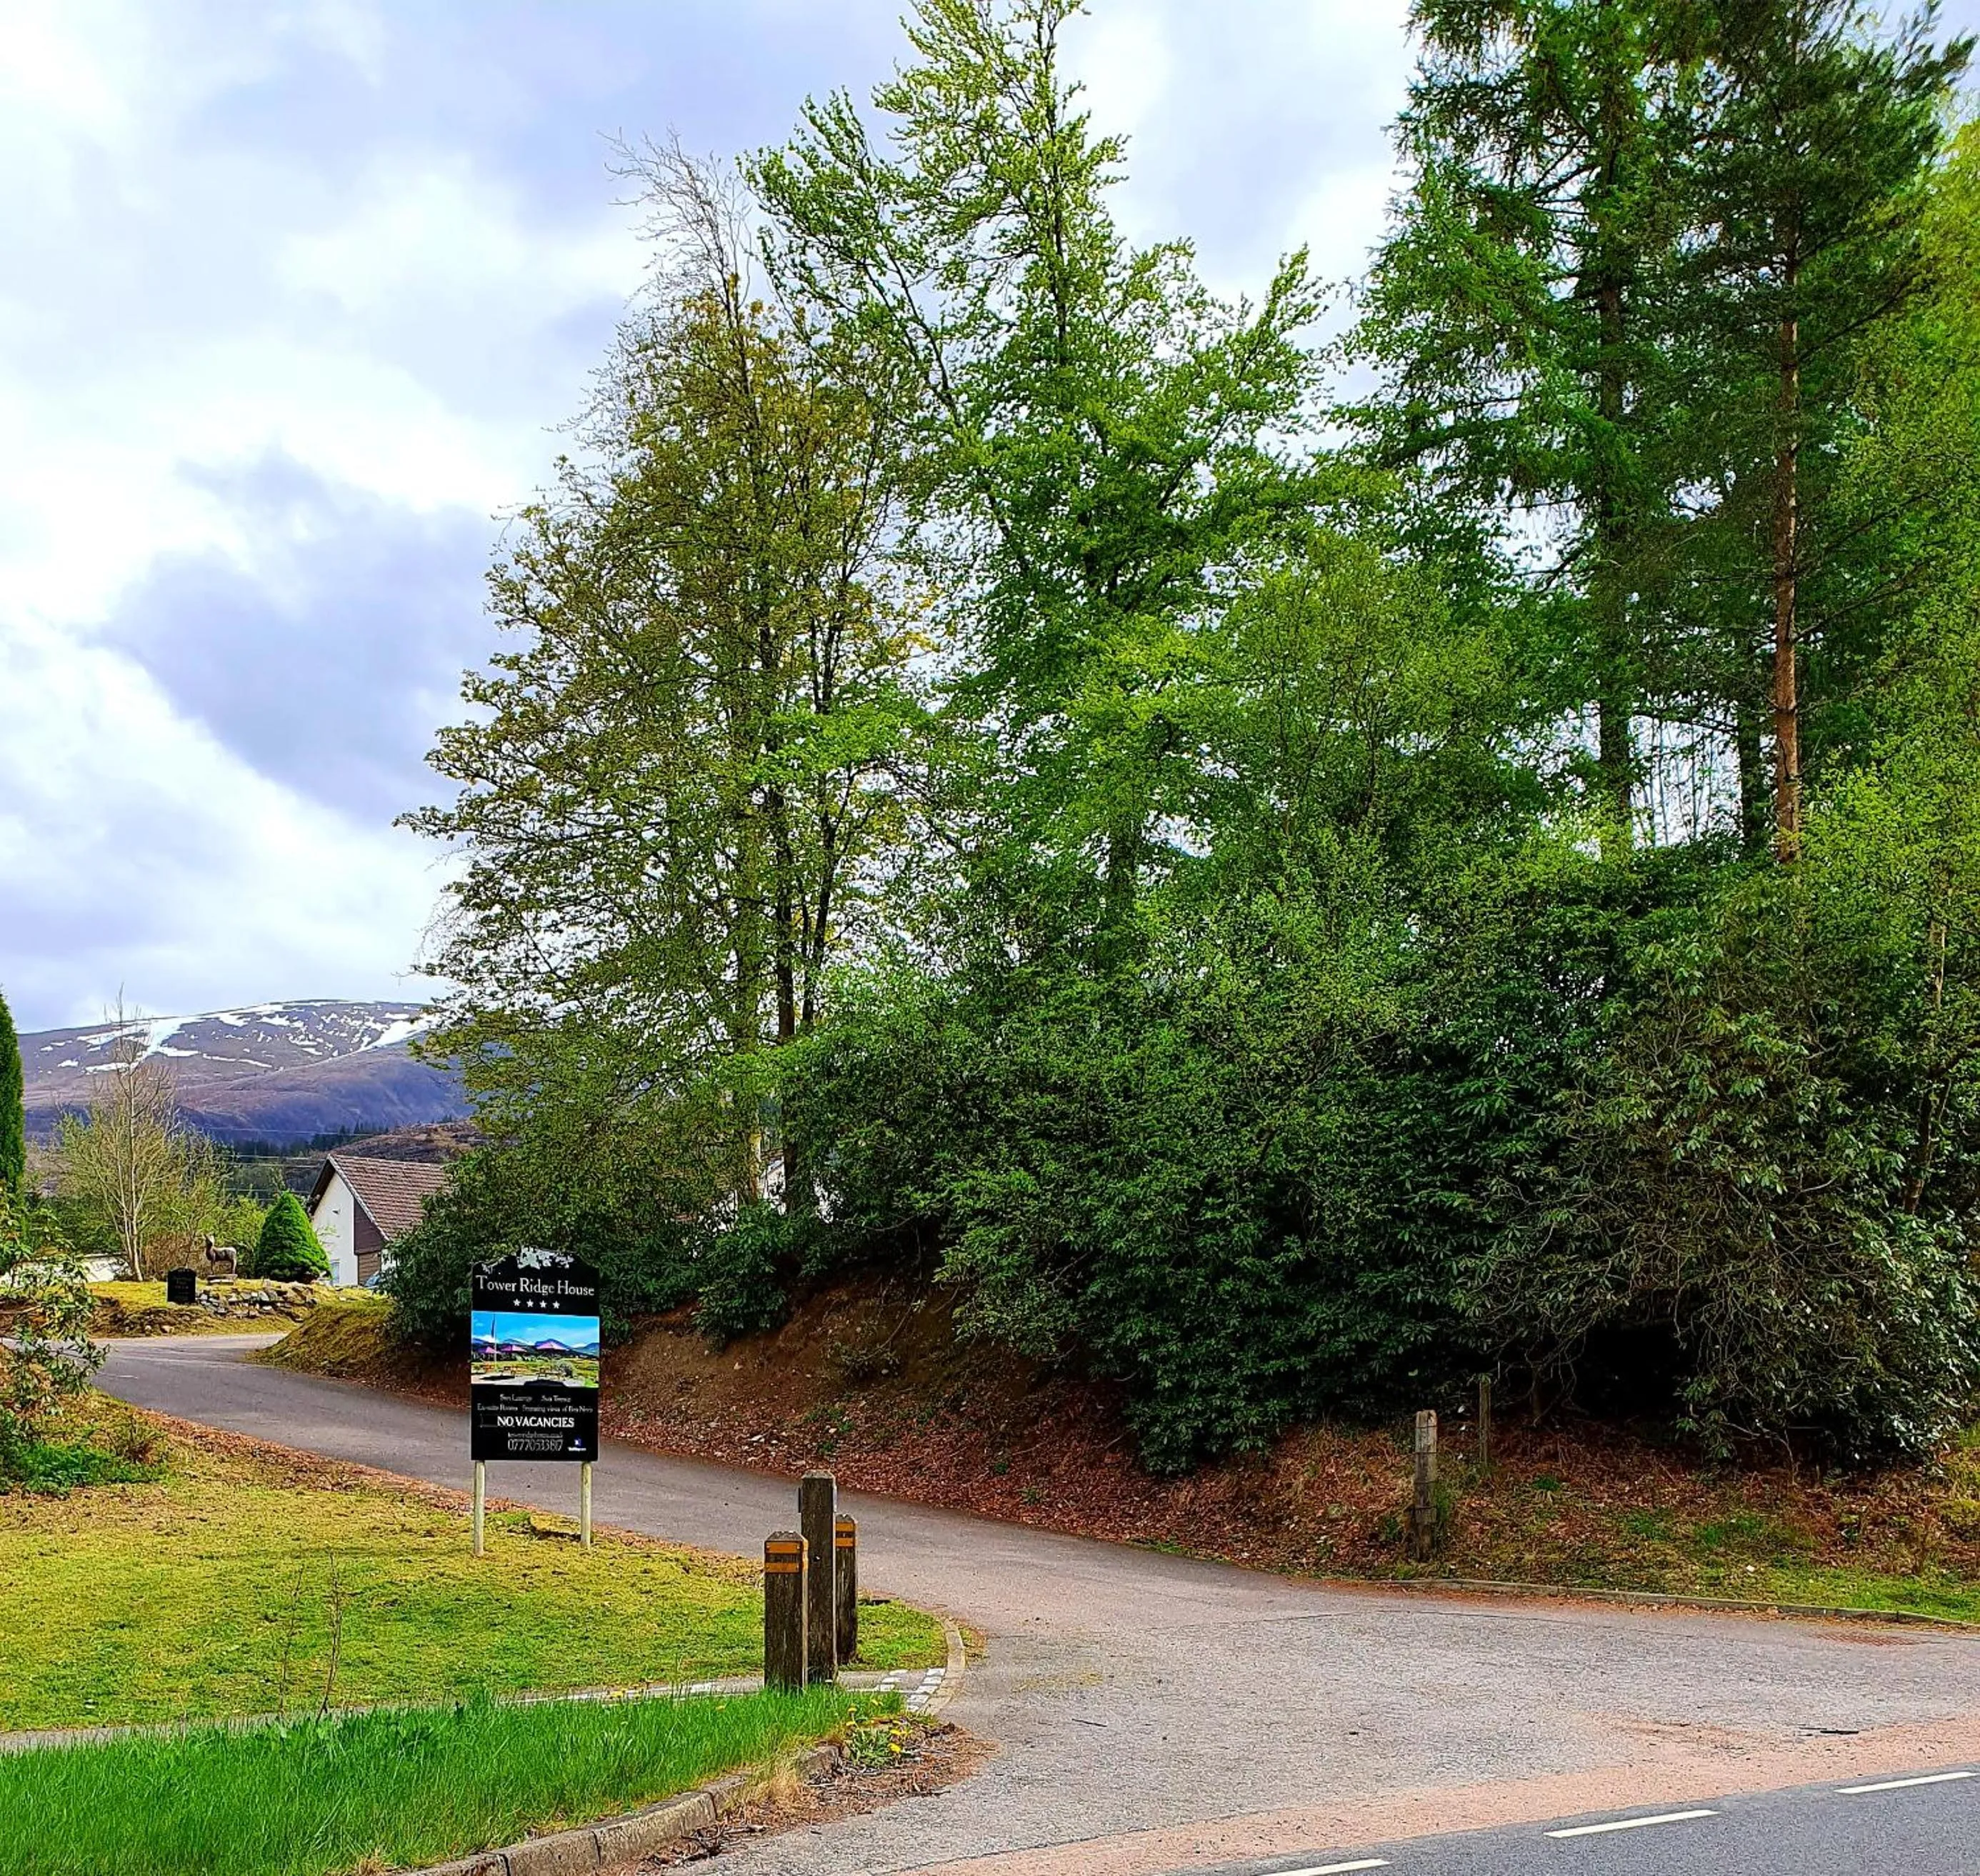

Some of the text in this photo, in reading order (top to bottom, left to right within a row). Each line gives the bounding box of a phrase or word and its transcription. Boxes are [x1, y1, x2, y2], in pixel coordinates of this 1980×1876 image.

[475, 1275, 594, 1295] Tower Ridge House
[497, 1416, 575, 1428] NO VACANCIES
